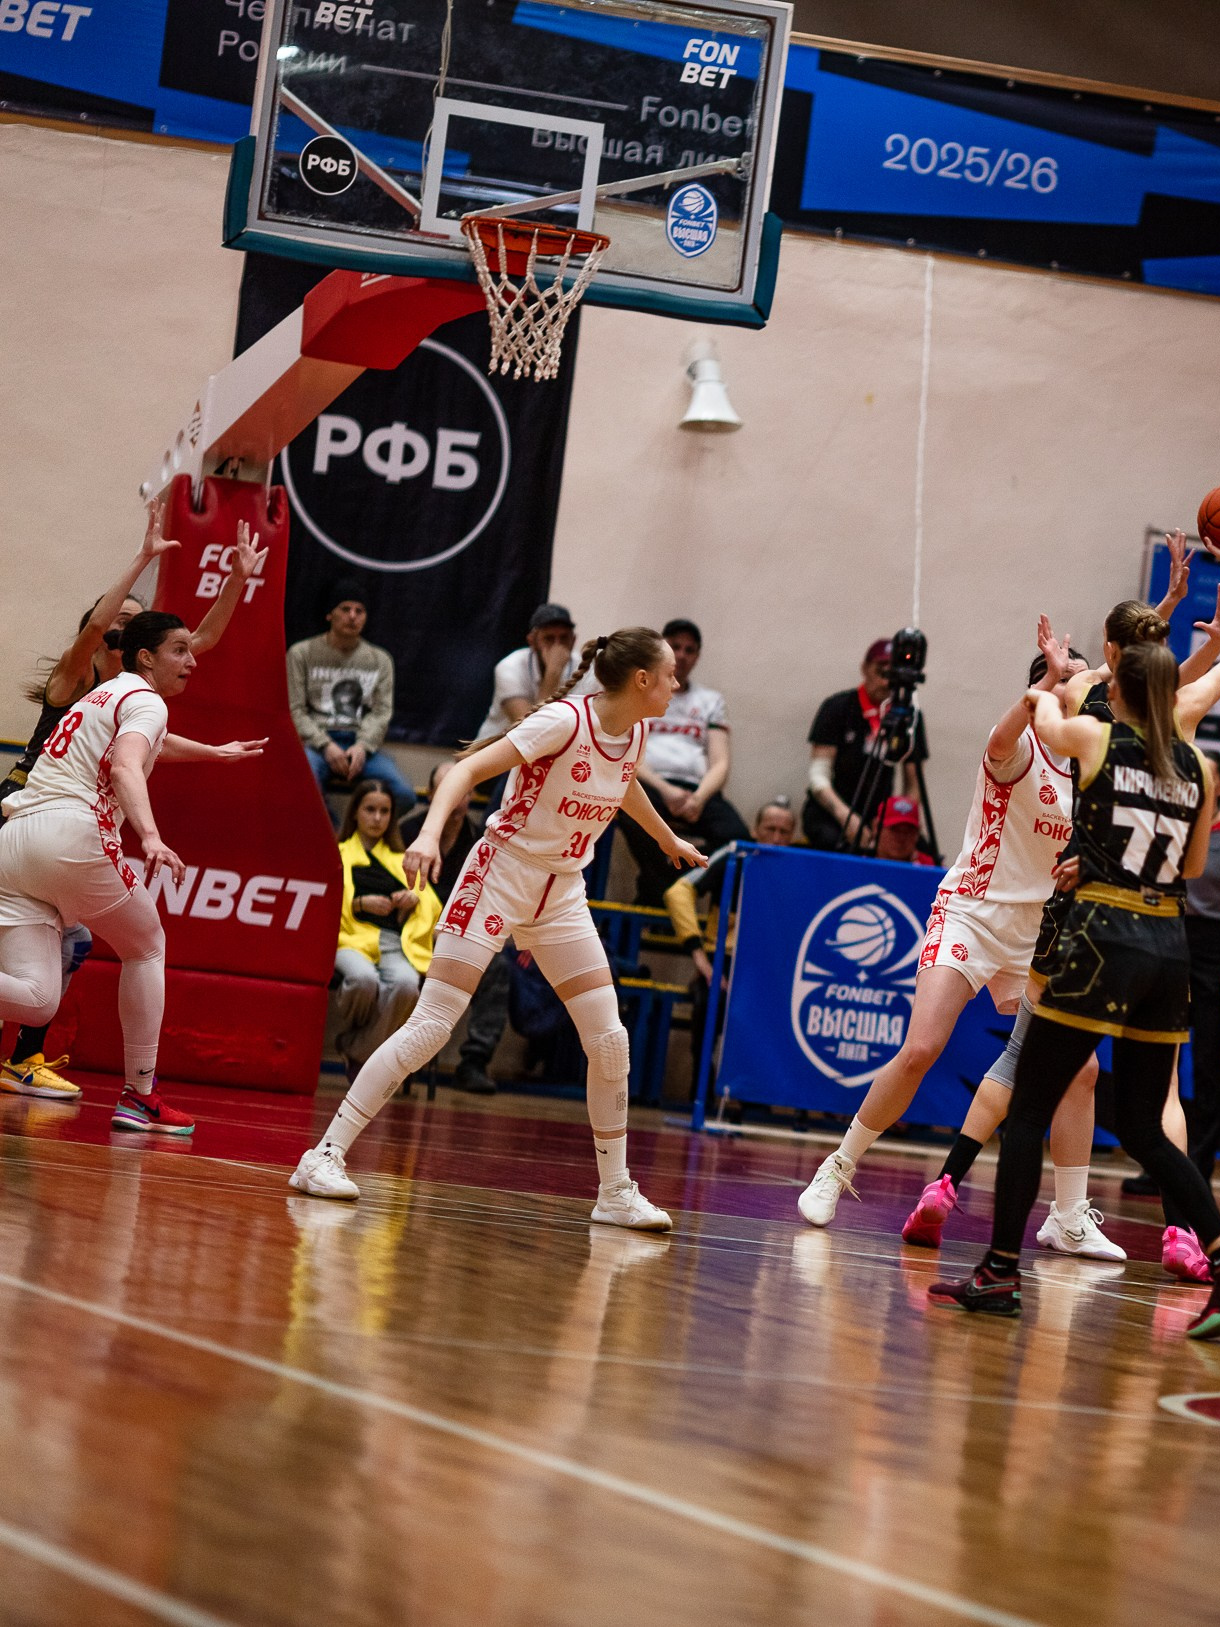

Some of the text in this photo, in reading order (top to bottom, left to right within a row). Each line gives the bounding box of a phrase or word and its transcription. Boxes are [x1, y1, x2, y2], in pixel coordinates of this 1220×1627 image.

[314, 1, 374, 28] BET
[683, 39, 740, 65] FON
[680, 62, 737, 89] BET
[307, 154, 352, 176] РФБ
[882, 133, 1059, 194] 2025/26
[313, 413, 482, 492] РФБ
[195, 571, 266, 604] BT
[1112, 805, 1191, 884] 77
[825, 983, 898, 1007] FONBET
[806, 1004, 904, 1047] ВЫСШАЯ
